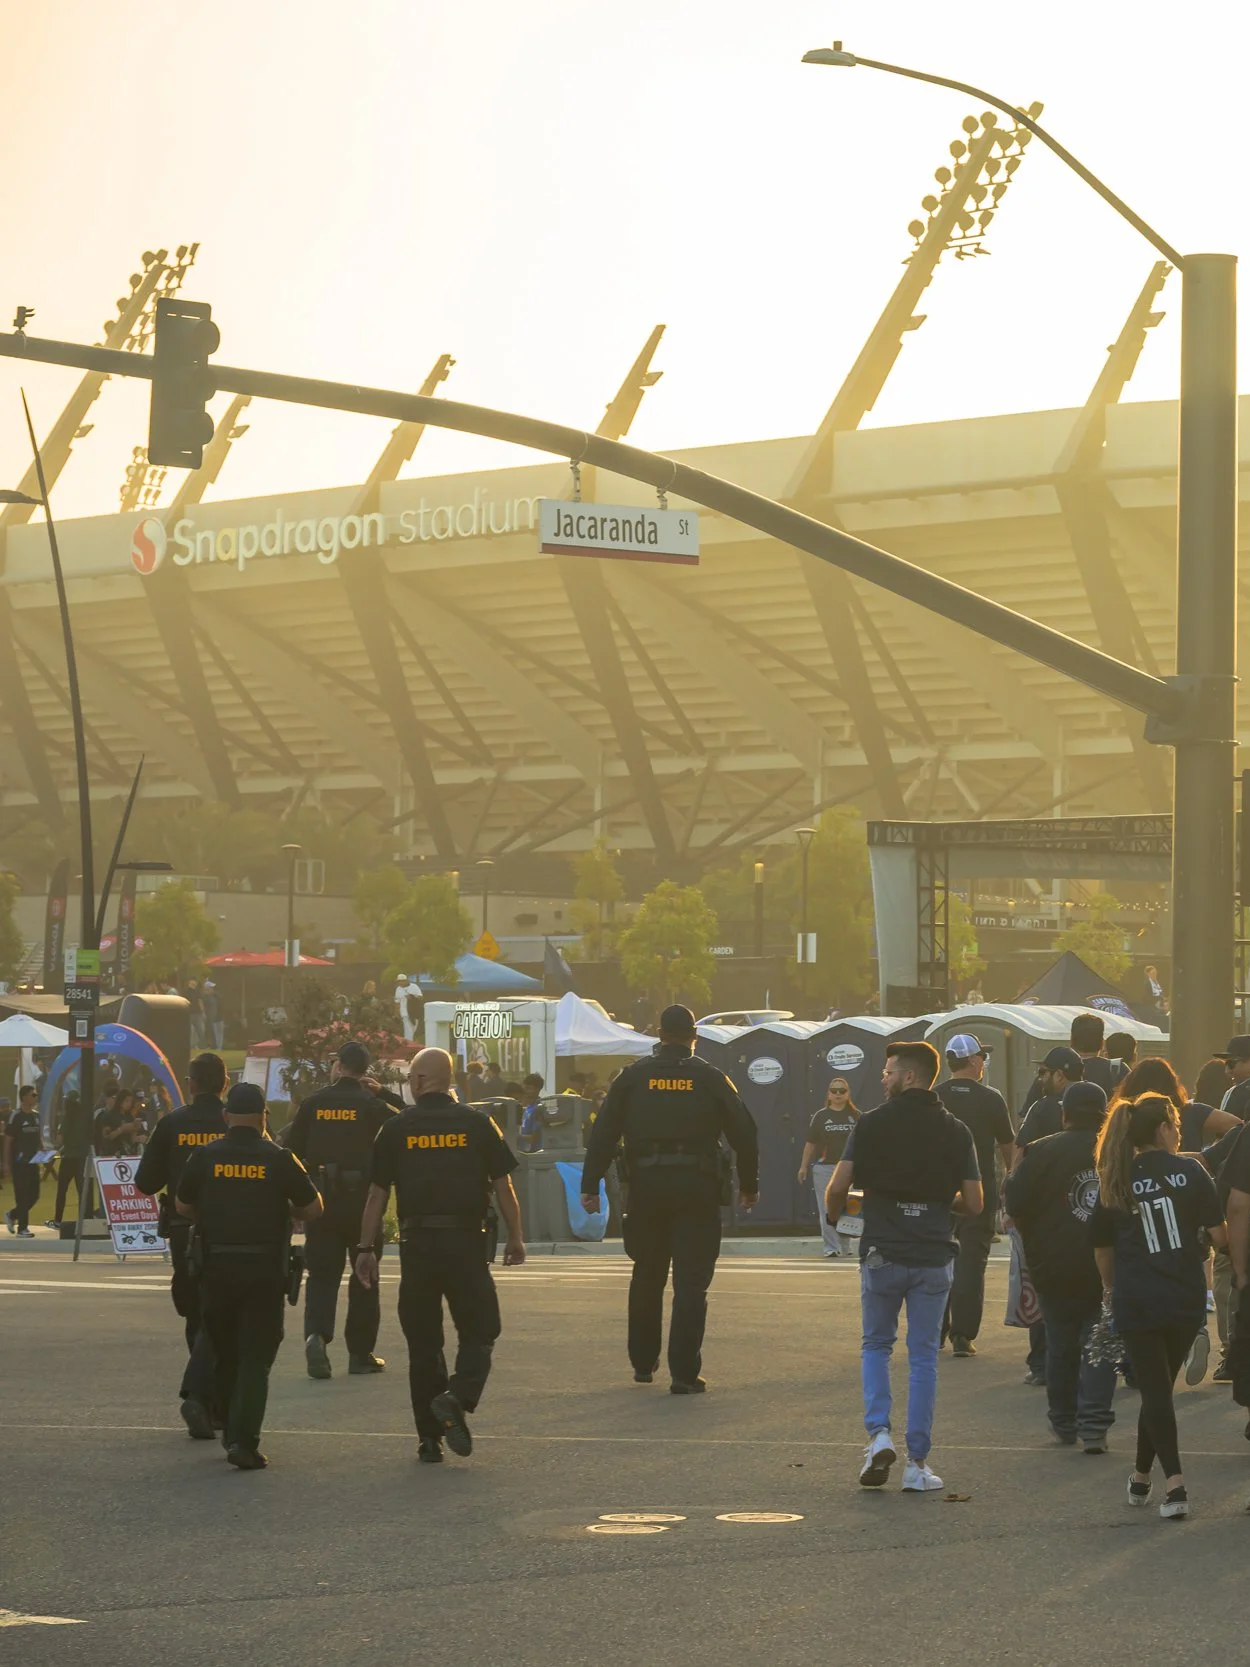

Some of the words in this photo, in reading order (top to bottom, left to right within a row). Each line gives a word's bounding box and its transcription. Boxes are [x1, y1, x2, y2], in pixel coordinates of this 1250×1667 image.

[173, 507, 385, 572] Snapdragon
[399, 486, 547, 543] stadium
[553, 508, 658, 545] Jacaranda
[678, 519, 690, 536] St
[65, 988, 93, 1001] 28541
[453, 1011, 513, 1039] CAFETON
[648, 1079, 694, 1091] POLICE
[316, 1109, 358, 1121] POLICE
[407, 1134, 468, 1149] POLICE
[214, 1164, 267, 1179] POLICE
[121, 1185, 135, 1196] NO
[1131, 1173, 1187, 1195] OZNO
[110, 1198, 152, 1211] PARKING
[110, 1212, 119, 1221] On
[120, 1212, 140, 1221] Event
[141, 1212, 158, 1221] Days
[903, 1209, 921, 1217] CLUB
[1132, 1196, 1182, 1254] 11
